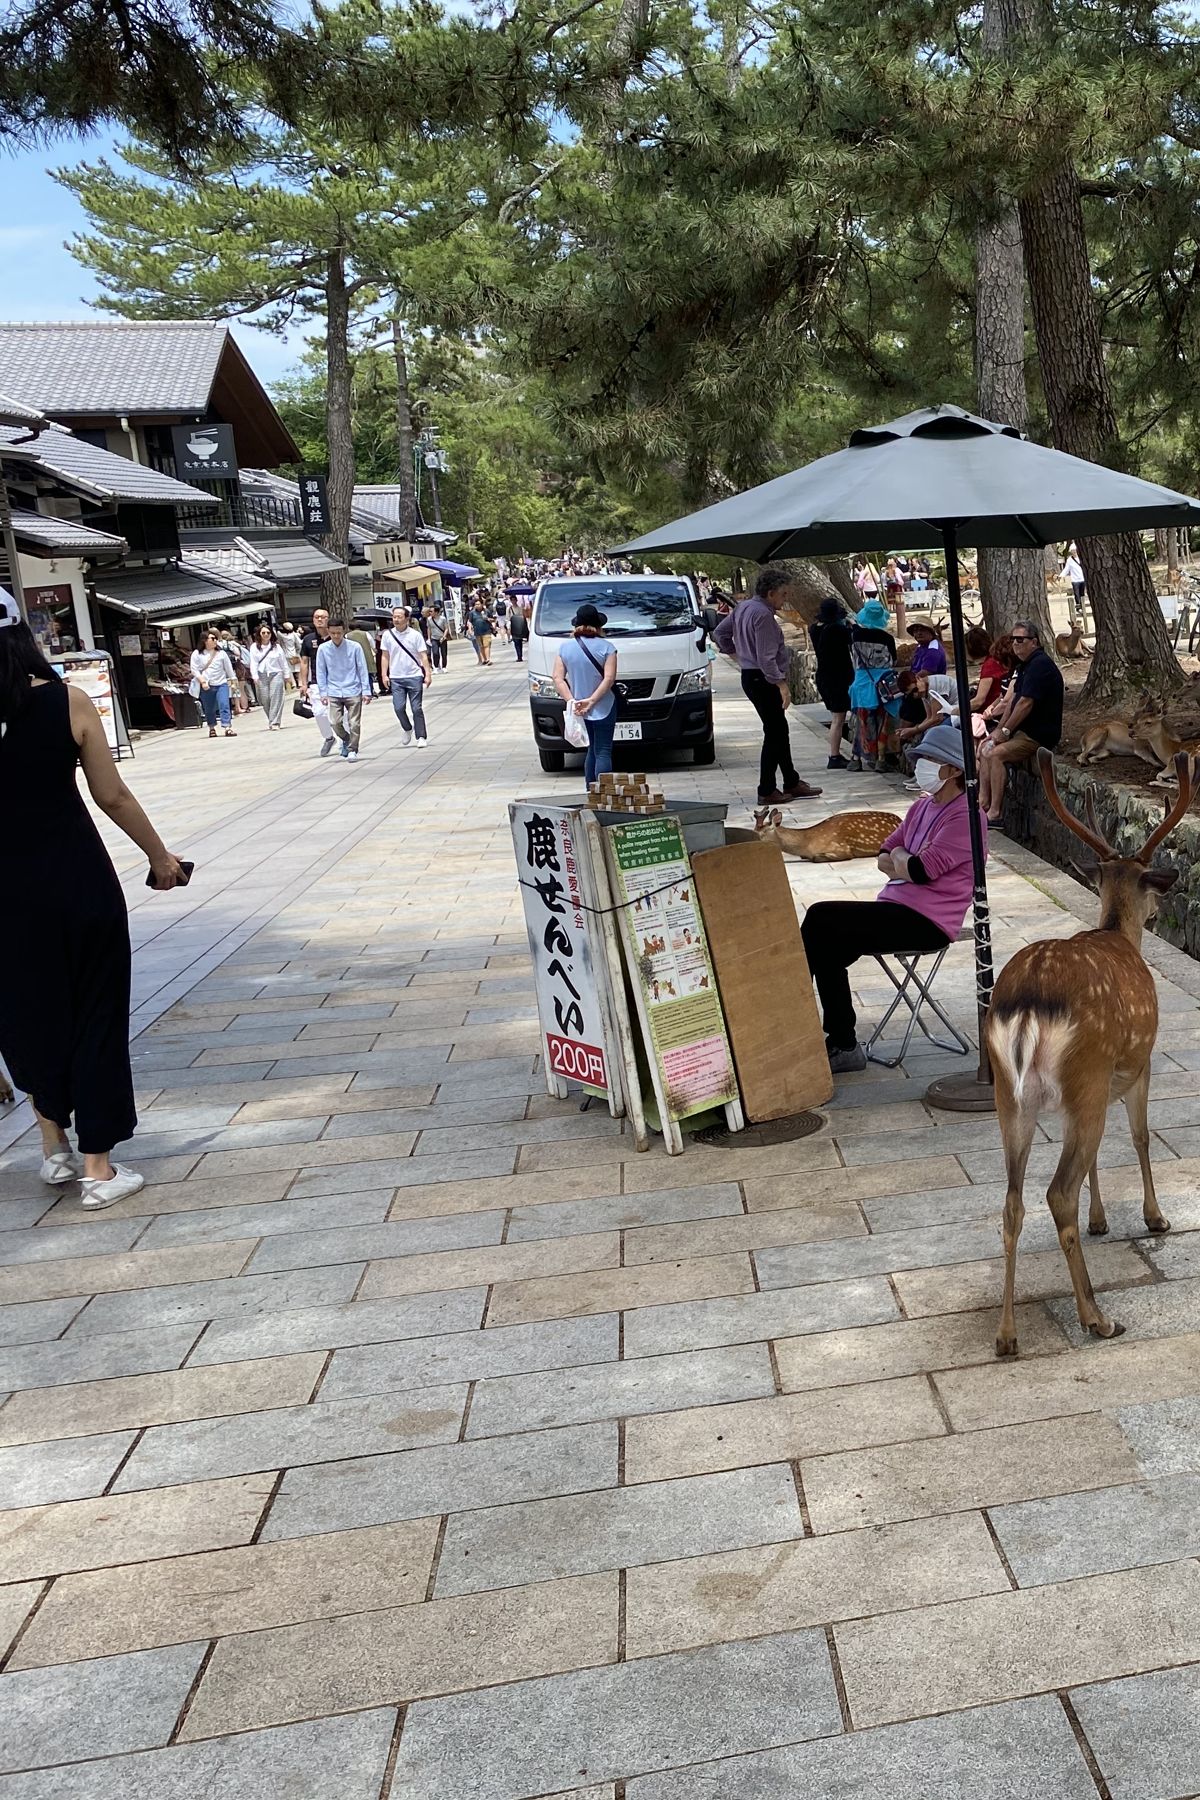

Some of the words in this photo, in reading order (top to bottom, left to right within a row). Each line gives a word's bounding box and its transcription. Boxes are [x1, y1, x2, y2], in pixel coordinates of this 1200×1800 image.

[634, 839, 651, 847] request
[524, 812, 585, 1037] 鹿せんべい
[551, 1039, 605, 1083] 200円
